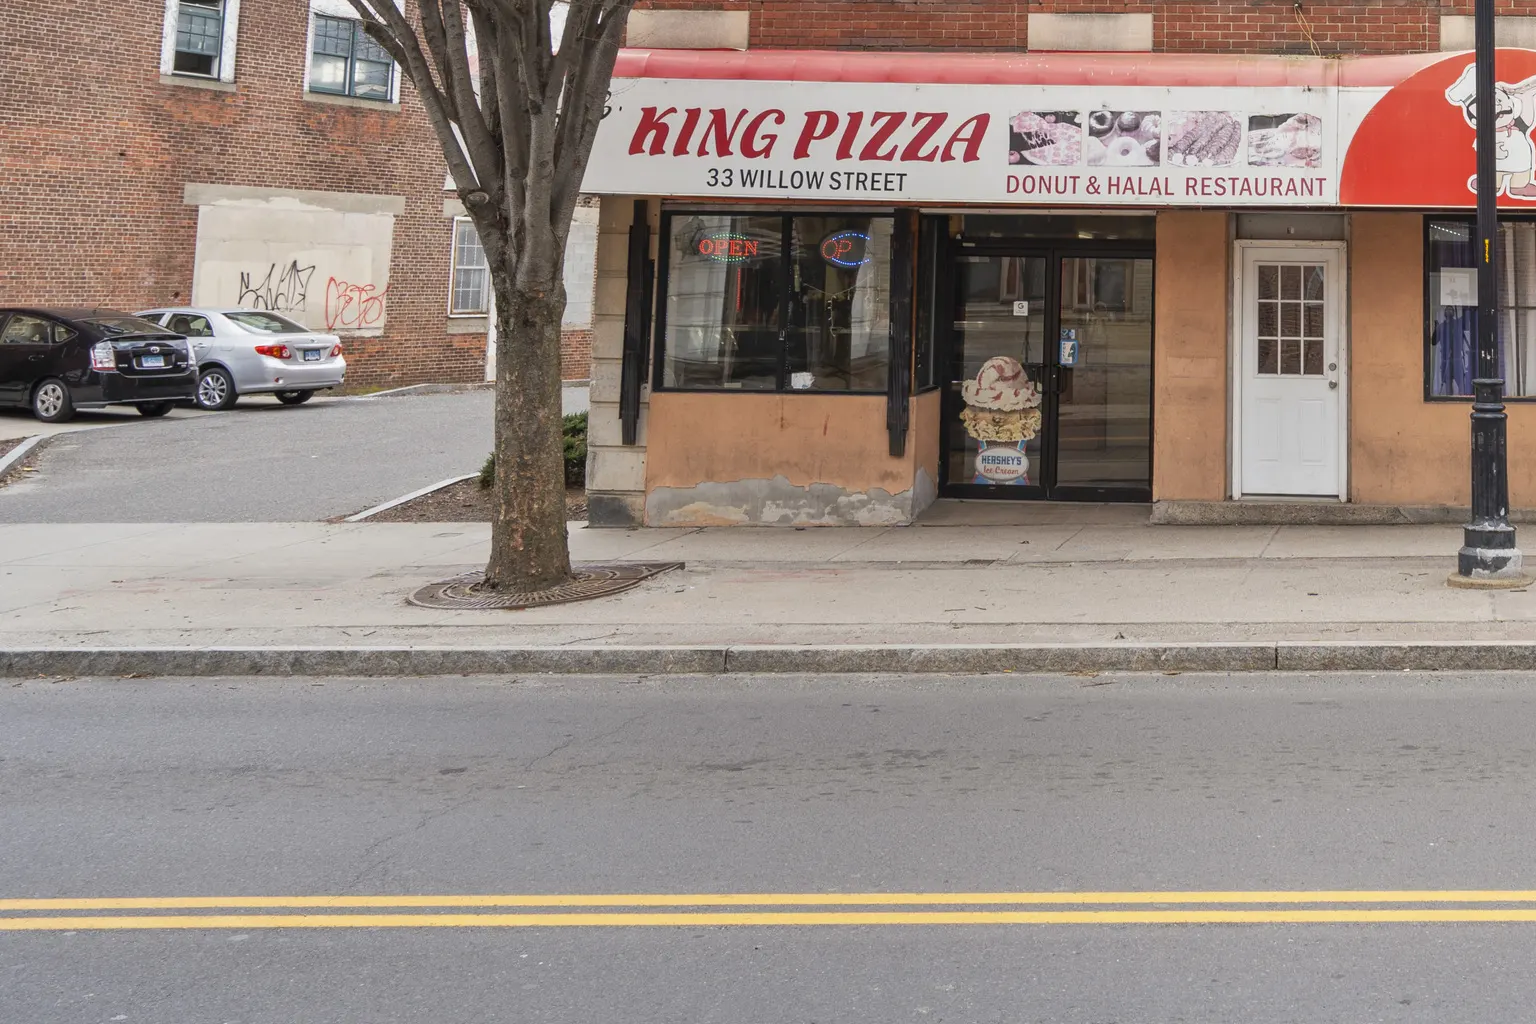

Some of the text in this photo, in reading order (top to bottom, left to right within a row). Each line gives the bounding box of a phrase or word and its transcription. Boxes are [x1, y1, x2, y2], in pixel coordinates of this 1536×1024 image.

[628, 106, 786, 160] KING
[793, 110, 991, 163] PIZZA
[706, 168, 908, 192] 33 WILLOW STREET
[1005, 175, 1328, 198] DONUT & HALAL RESTAURANT
[699, 239, 759, 256] OPEN
[981, 455, 1022, 466] HERSHEY'S
[983, 466, 1019, 475] Ice Cream
